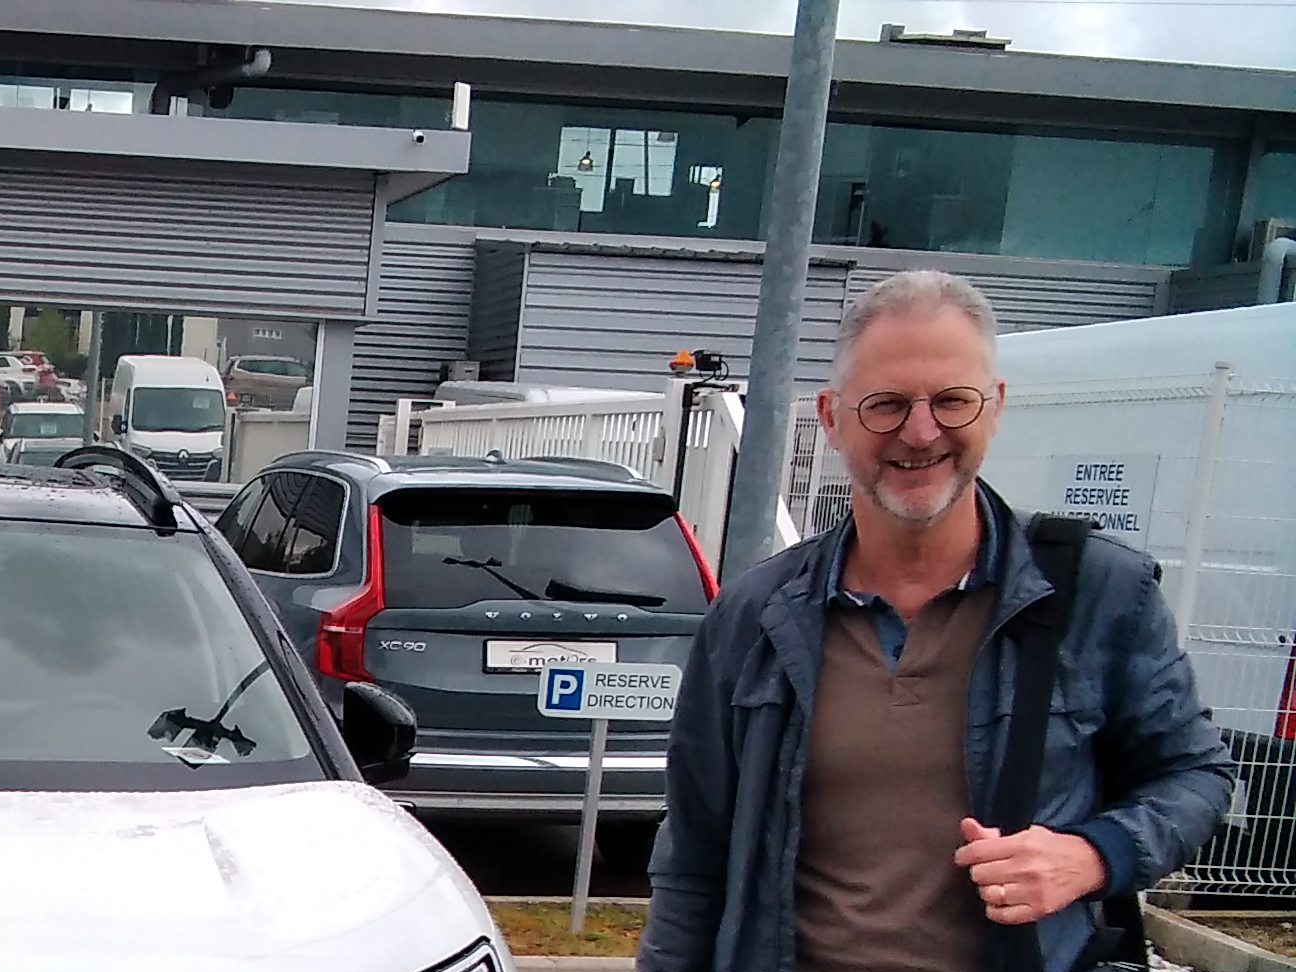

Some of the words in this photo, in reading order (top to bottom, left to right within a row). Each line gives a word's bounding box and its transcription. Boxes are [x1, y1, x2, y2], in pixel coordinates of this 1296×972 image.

[1075, 460, 1125, 482] ENTRÉE
[1065, 485, 1130, 506] RESERVÉE
[378, 639, 427, 652] XC90
[551, 674, 578, 705] P
[595, 673, 671, 689] RESERVE
[587, 693, 674, 710] DIRECTION
